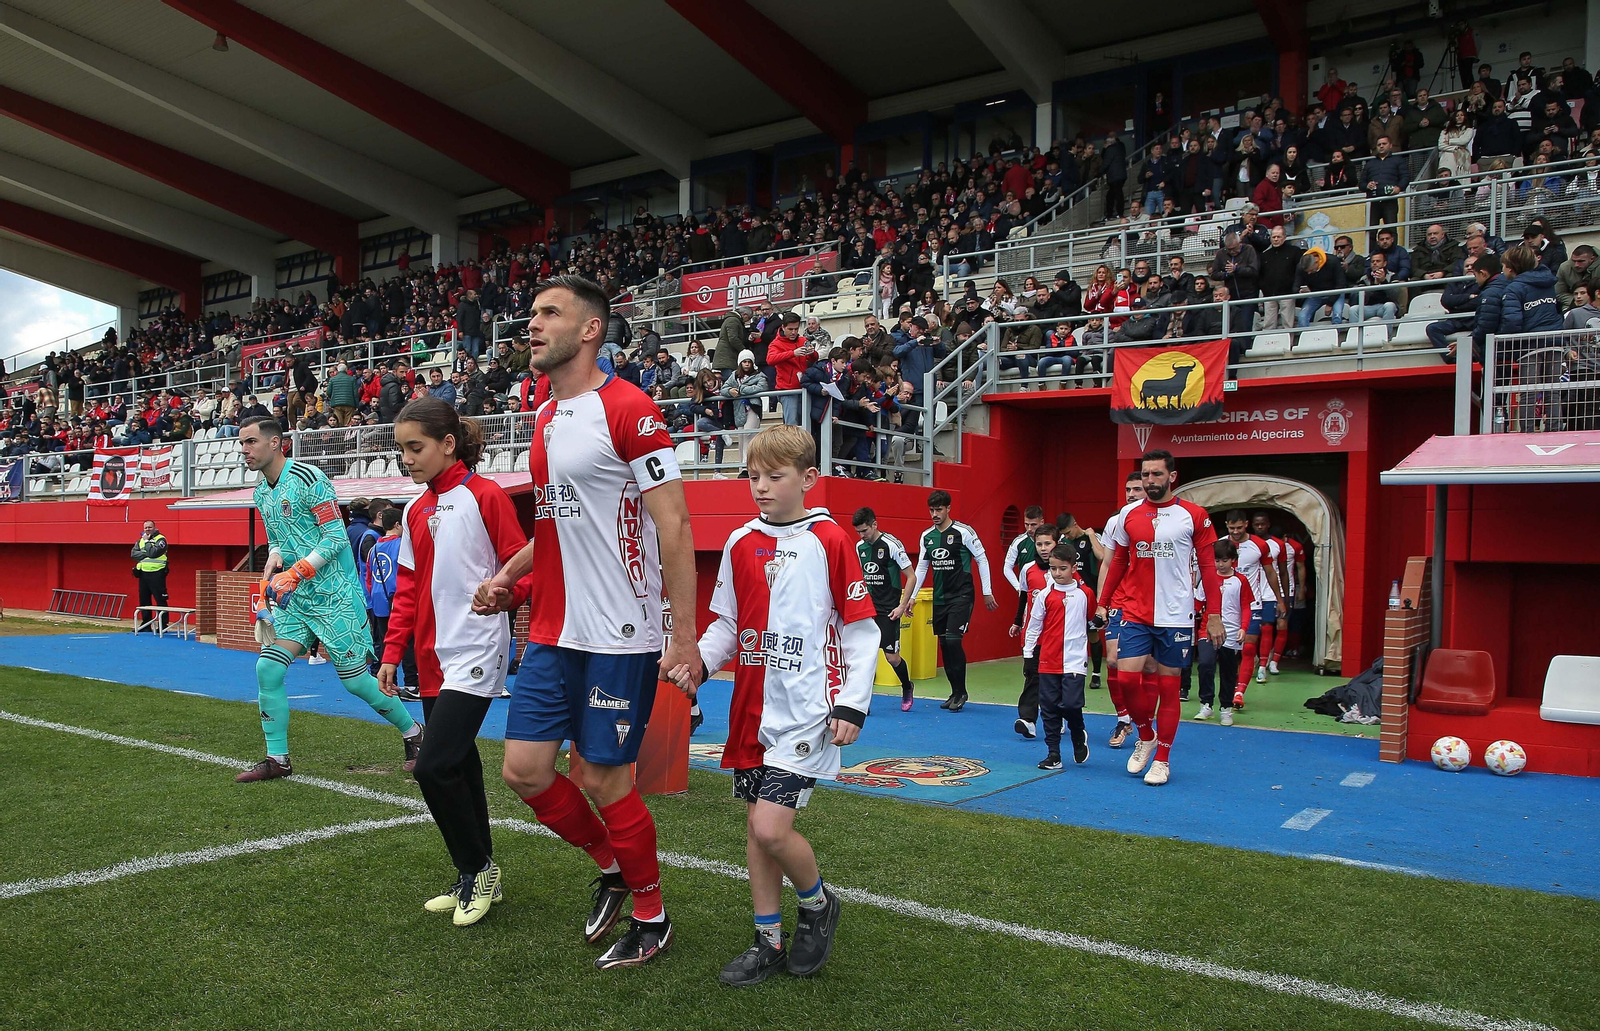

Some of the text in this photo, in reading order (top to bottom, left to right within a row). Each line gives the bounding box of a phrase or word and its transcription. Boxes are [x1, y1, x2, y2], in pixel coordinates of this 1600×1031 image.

[1531, 297, 1557, 307] GIVOV
[1284, 407, 1310, 420] CF
[1171, 428, 1305, 443] Ayuntamiento de Algeciras
[645, 456, 666, 482] C
[422, 504, 454, 514] GIVOVA
[755, 548, 798, 559] GIVOVA
[761, 632, 804, 657] 威视
